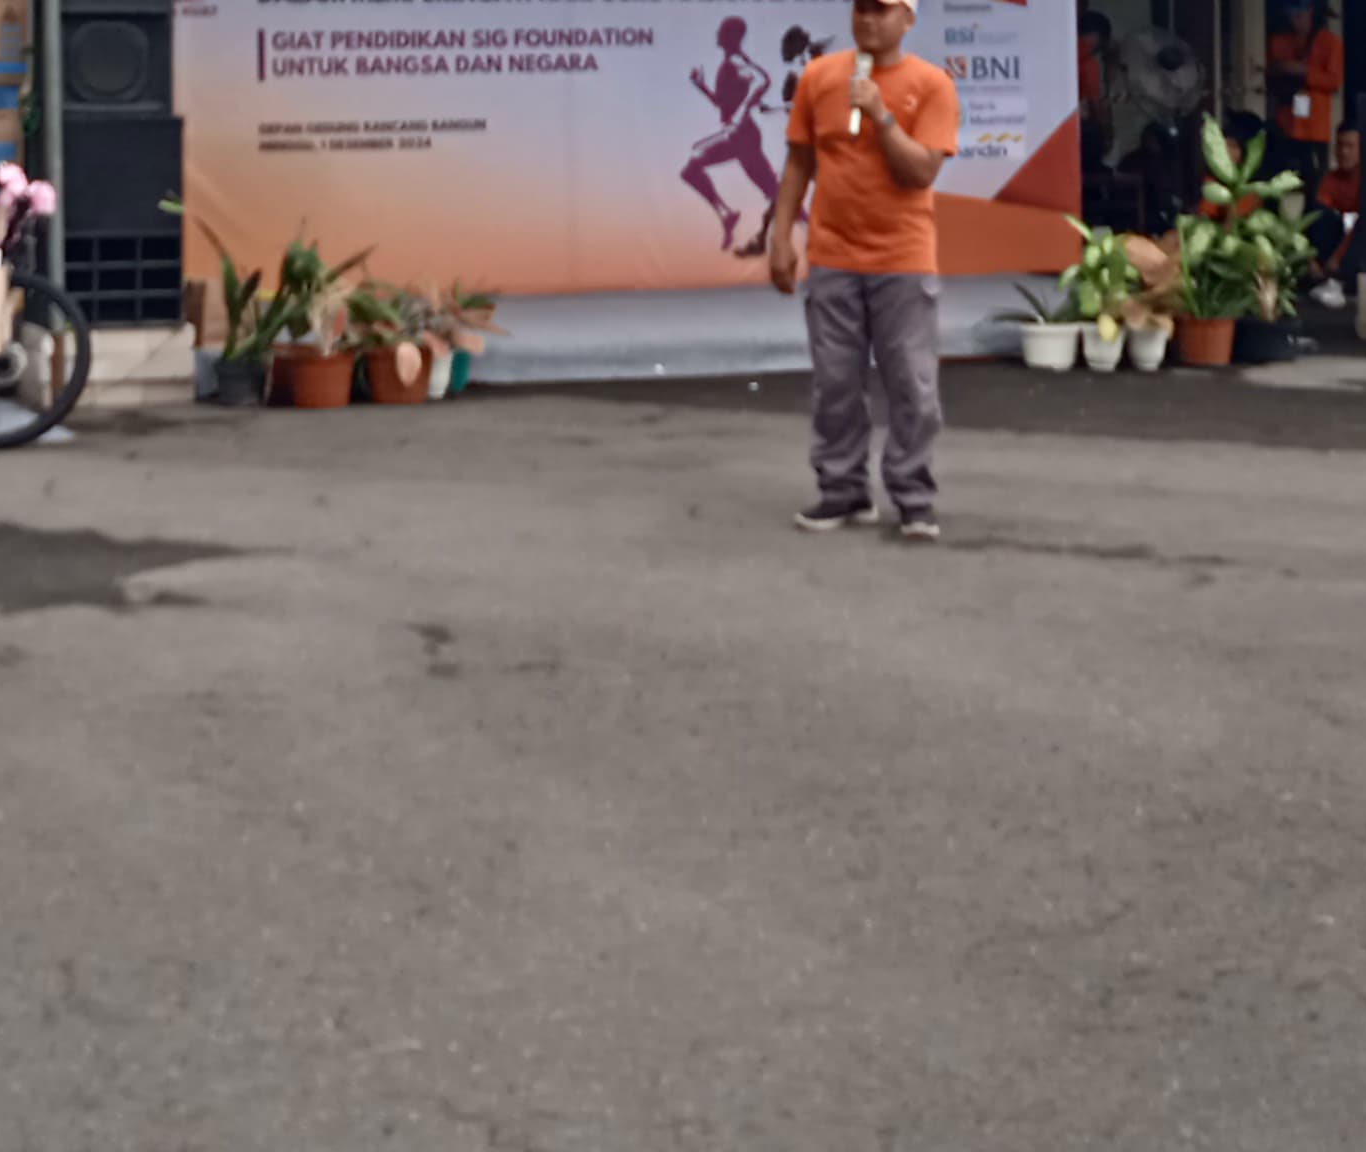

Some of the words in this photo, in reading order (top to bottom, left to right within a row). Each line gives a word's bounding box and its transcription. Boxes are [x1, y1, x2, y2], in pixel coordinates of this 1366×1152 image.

[272, 31, 325, 50] GIAT
[330, 29, 465, 49] PENDIDIKAN
[472, 29, 507, 48] SIG
[514, 28, 653, 47] FOUNDATION
[272, 56, 348, 76] UNTUK
[355, 55, 449, 75] BANGSA
[455, 54, 502, 73] DAN
[509, 54, 599, 73] NEGARA
[971, 55, 1020, 80] BNI
